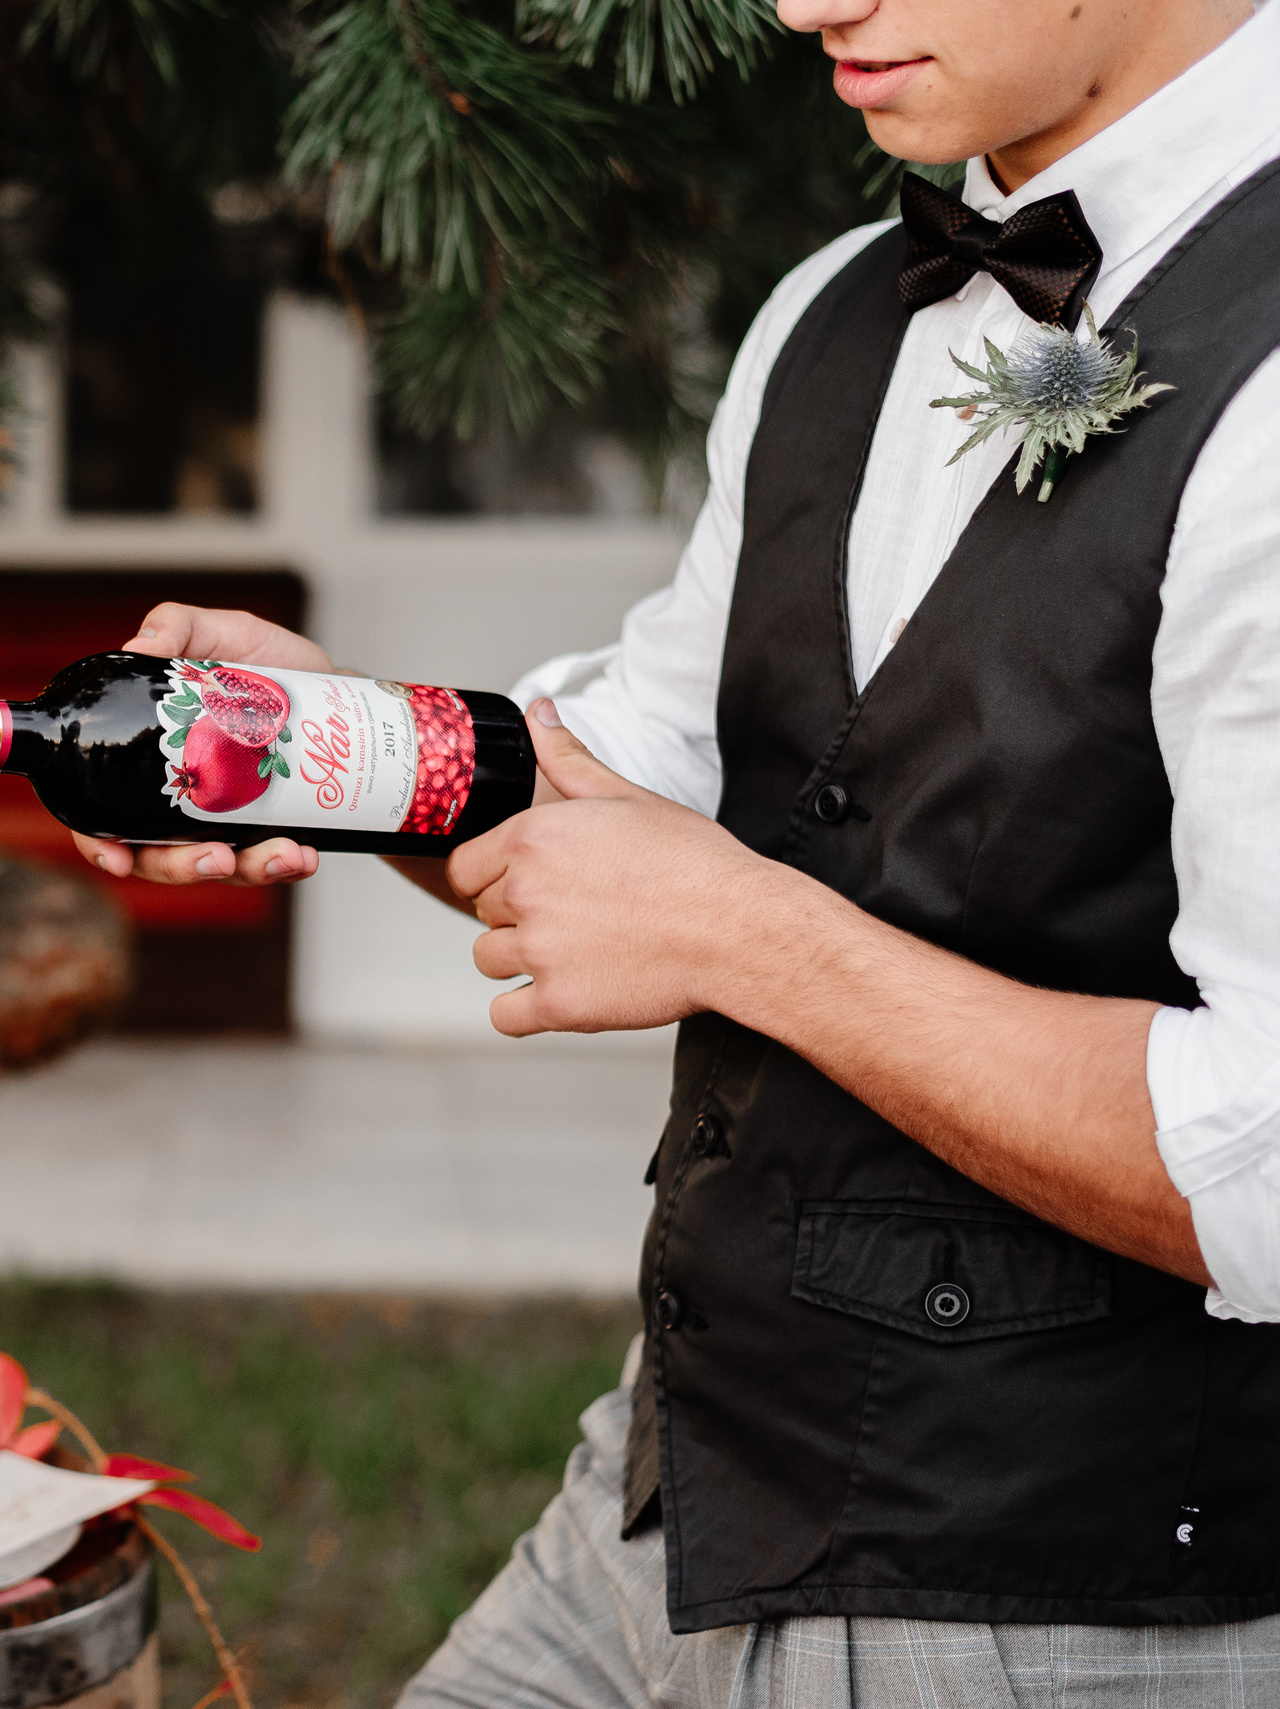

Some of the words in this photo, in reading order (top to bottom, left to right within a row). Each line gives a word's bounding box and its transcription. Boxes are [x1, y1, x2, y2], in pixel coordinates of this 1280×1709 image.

[299, 713, 351, 810] Nar
[369, 726, 377, 776] натуральное
[383, 721, 396, 758] 2017
[367, 777, 375, 794] вино
[389, 777, 411, 820] Product
[402, 762, 416, 776] of
